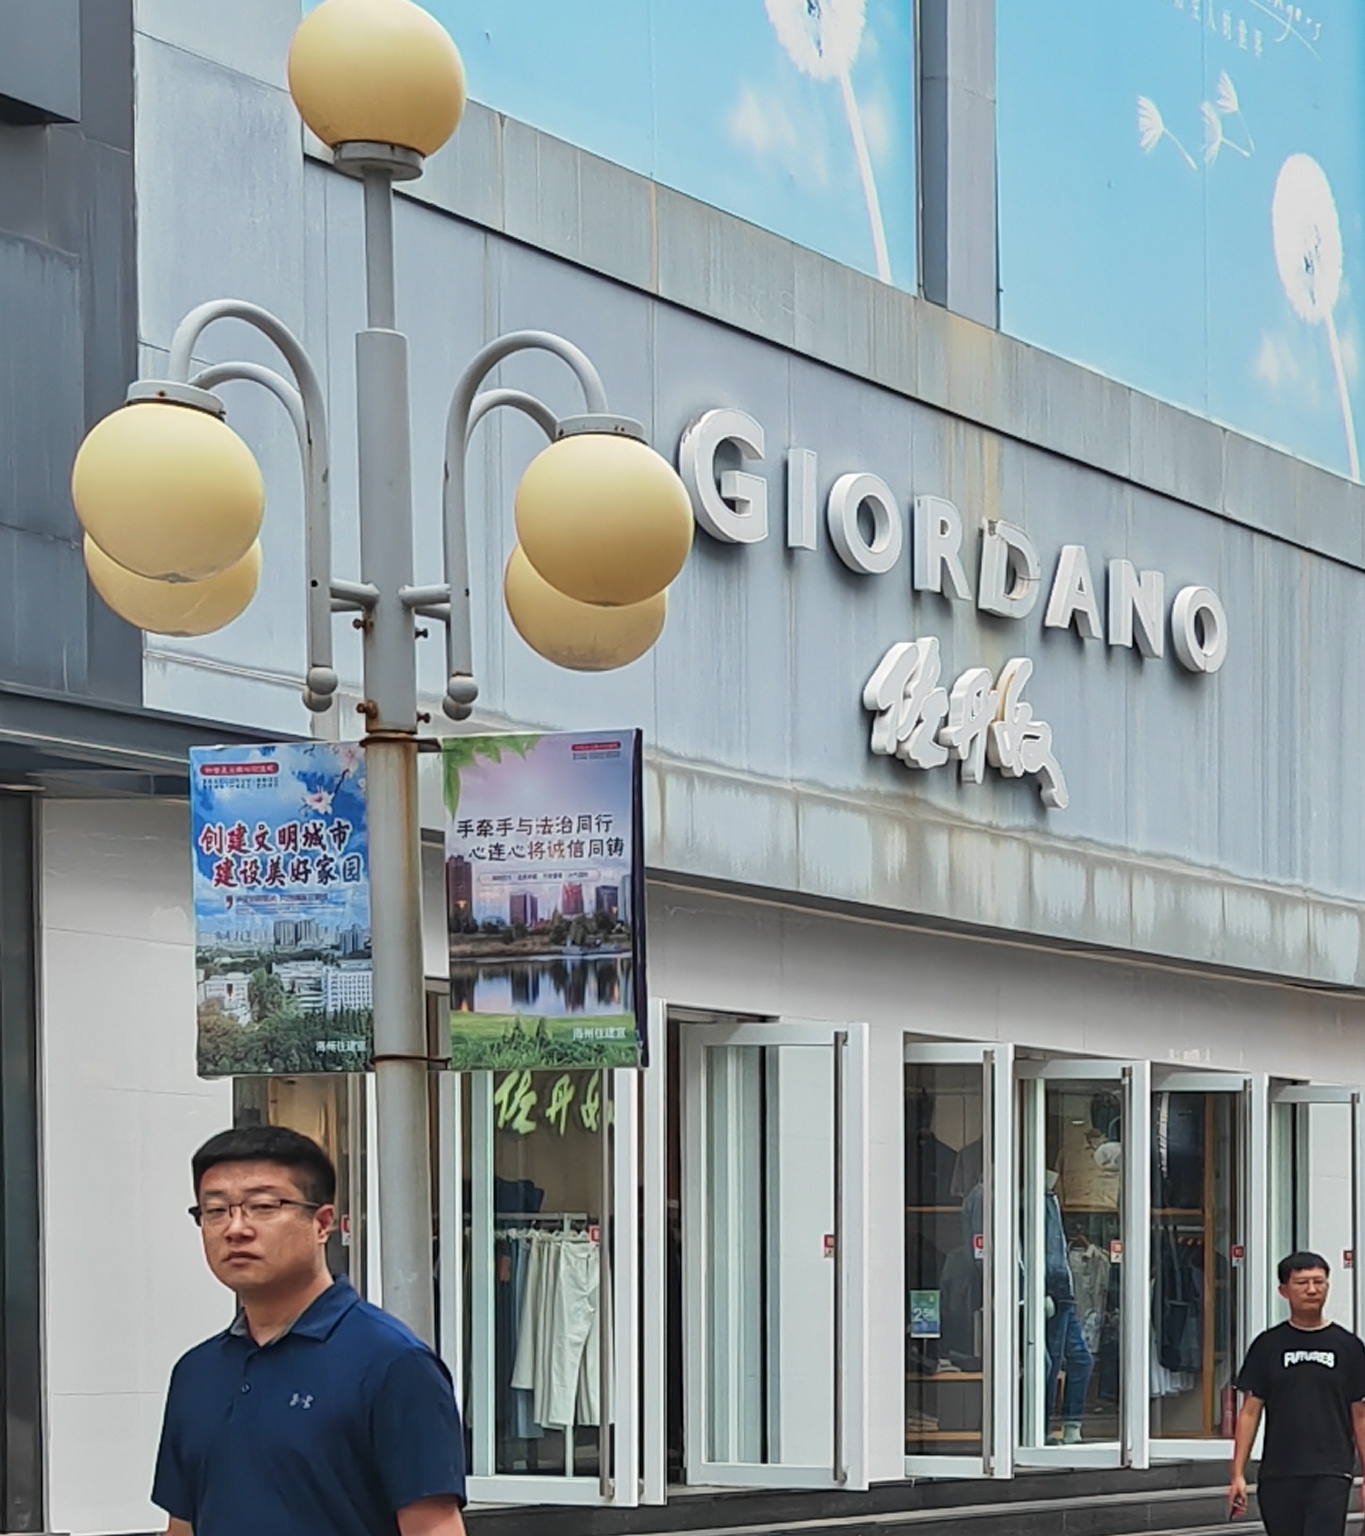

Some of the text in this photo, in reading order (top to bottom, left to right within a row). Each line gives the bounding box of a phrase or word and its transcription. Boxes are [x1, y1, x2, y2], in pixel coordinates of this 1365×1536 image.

[679, 408, 1228, 674] GIORDANO
[200, 820, 352, 856] 创建文明城市
[456, 813, 613, 839] 手牵手与法治同行
[213, 853, 362, 889] 建设美好家园
